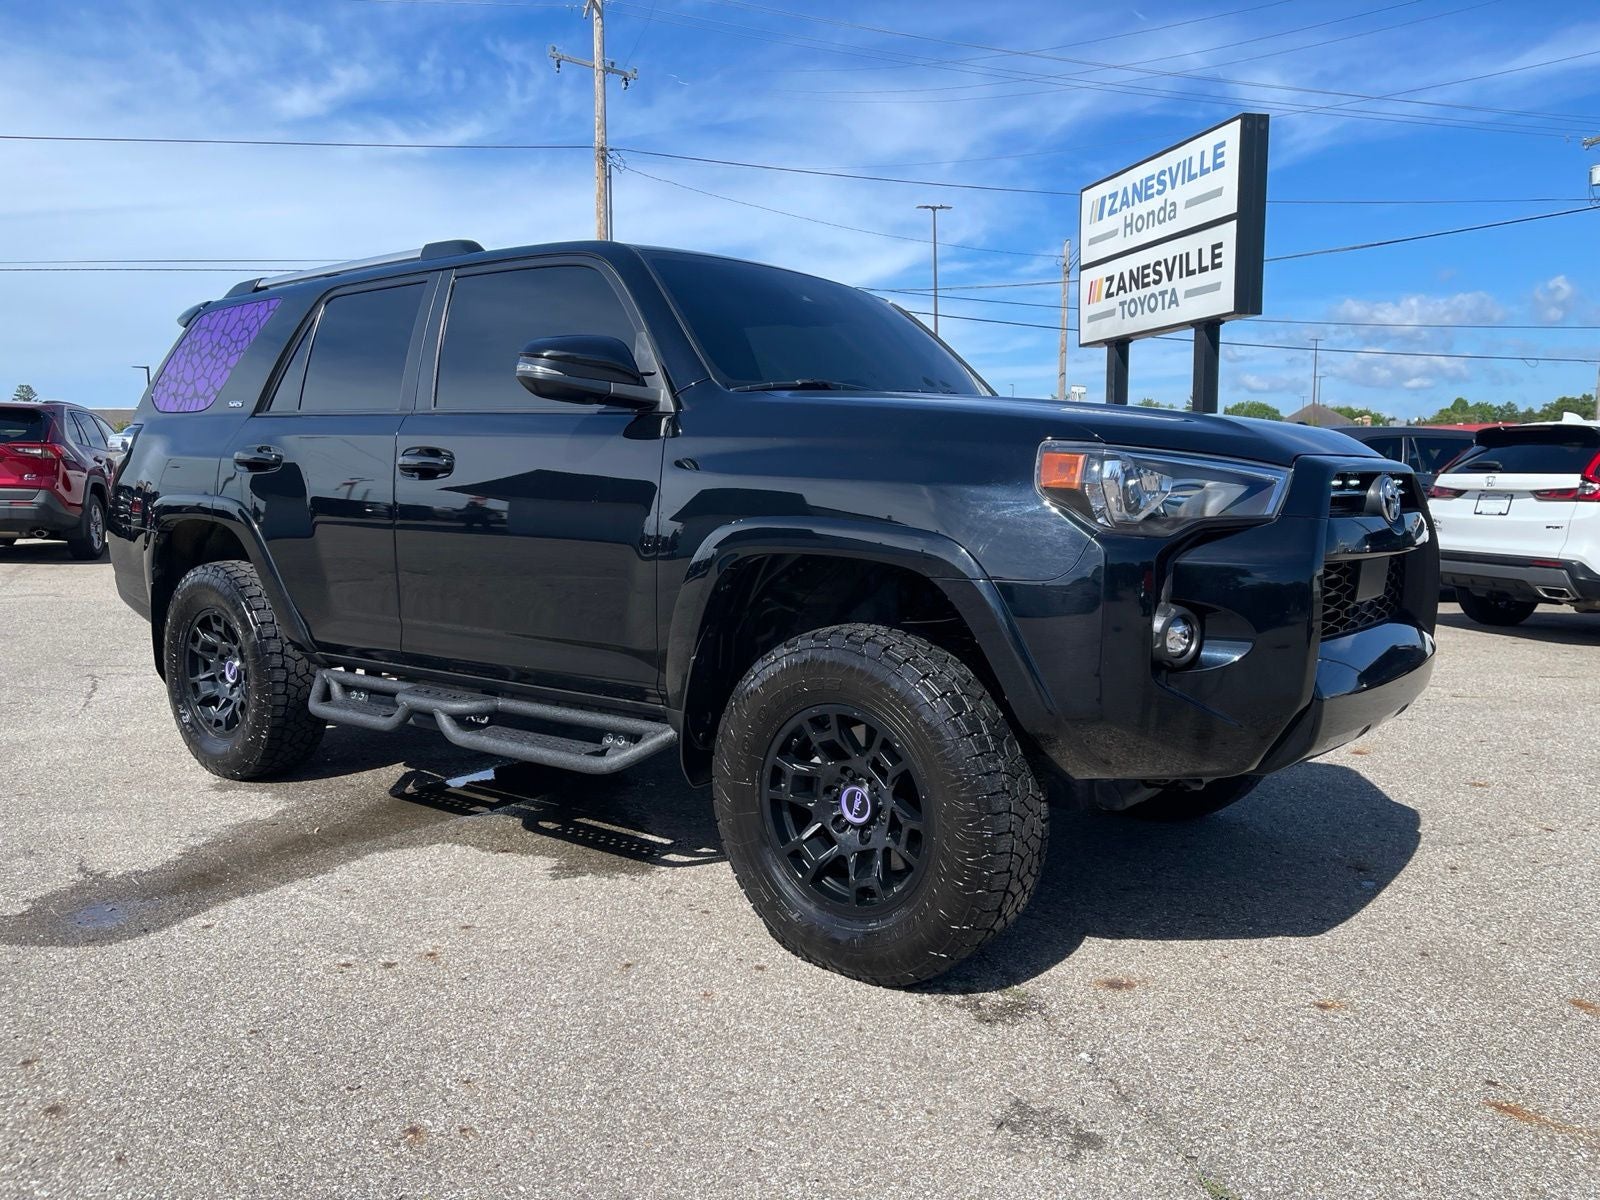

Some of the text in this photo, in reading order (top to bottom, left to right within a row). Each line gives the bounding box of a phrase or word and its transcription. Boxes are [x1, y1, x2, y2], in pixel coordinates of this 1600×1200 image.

[1107, 140, 1226, 217] ZANESVILLE
[1123, 198, 1177, 238] Honda
[1104, 241, 1223, 299] ZANESVILLE
[1118, 287, 1180, 320] TOYOTA
[851, 791, 862, 817] TRD
